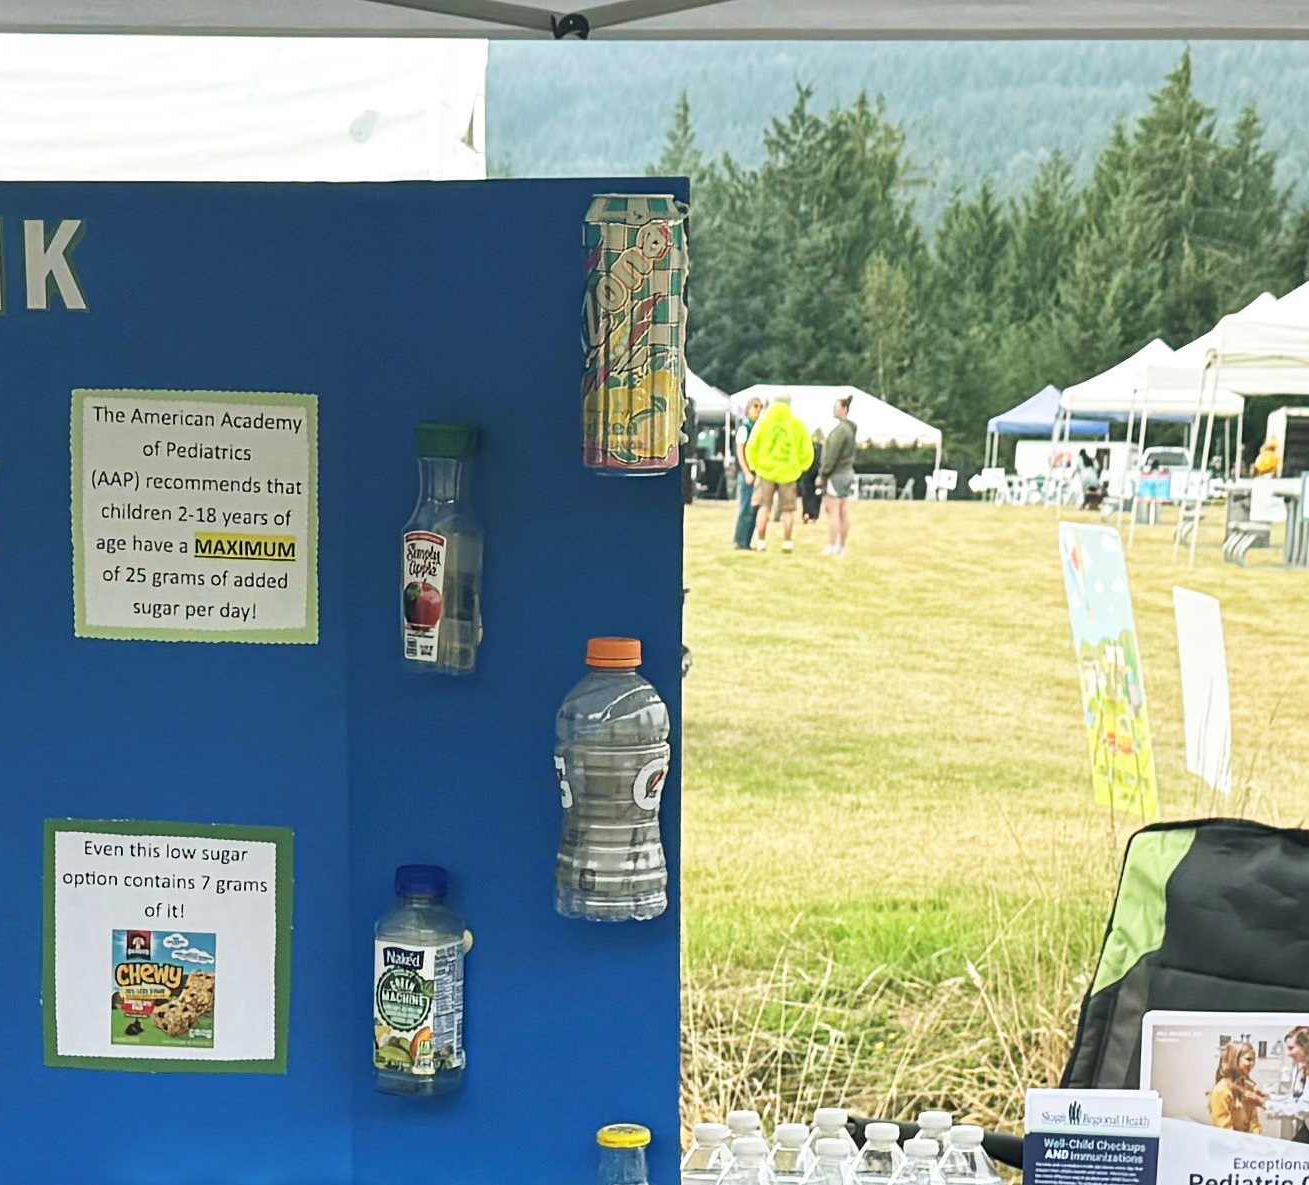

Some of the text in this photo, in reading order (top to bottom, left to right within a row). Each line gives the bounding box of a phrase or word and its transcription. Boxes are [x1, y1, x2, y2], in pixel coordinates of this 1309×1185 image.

[93, 406, 302, 434] The American Academy
[143, 441, 252, 461] of Pediatrics
[91, 470, 302, 495] (AAP) recommends that
[101, 503, 291, 527] children 2-18 years of
[96, 535, 296, 558] age have a MAXIMUM
[102, 565, 288, 589] of 25 grams of added
[133, 601, 257, 621] sugar per day!
[85, 840, 248, 865] Even this low sugar
[62, 871, 268, 894] option contains 7 grams
[145, 902, 184, 918] of it!
[387, 950, 420, 967] Naked
[1044, 1138, 1146, 1155] Well-Child Checkups
[1045, 1149, 1144, 1165] AND Immunizations
